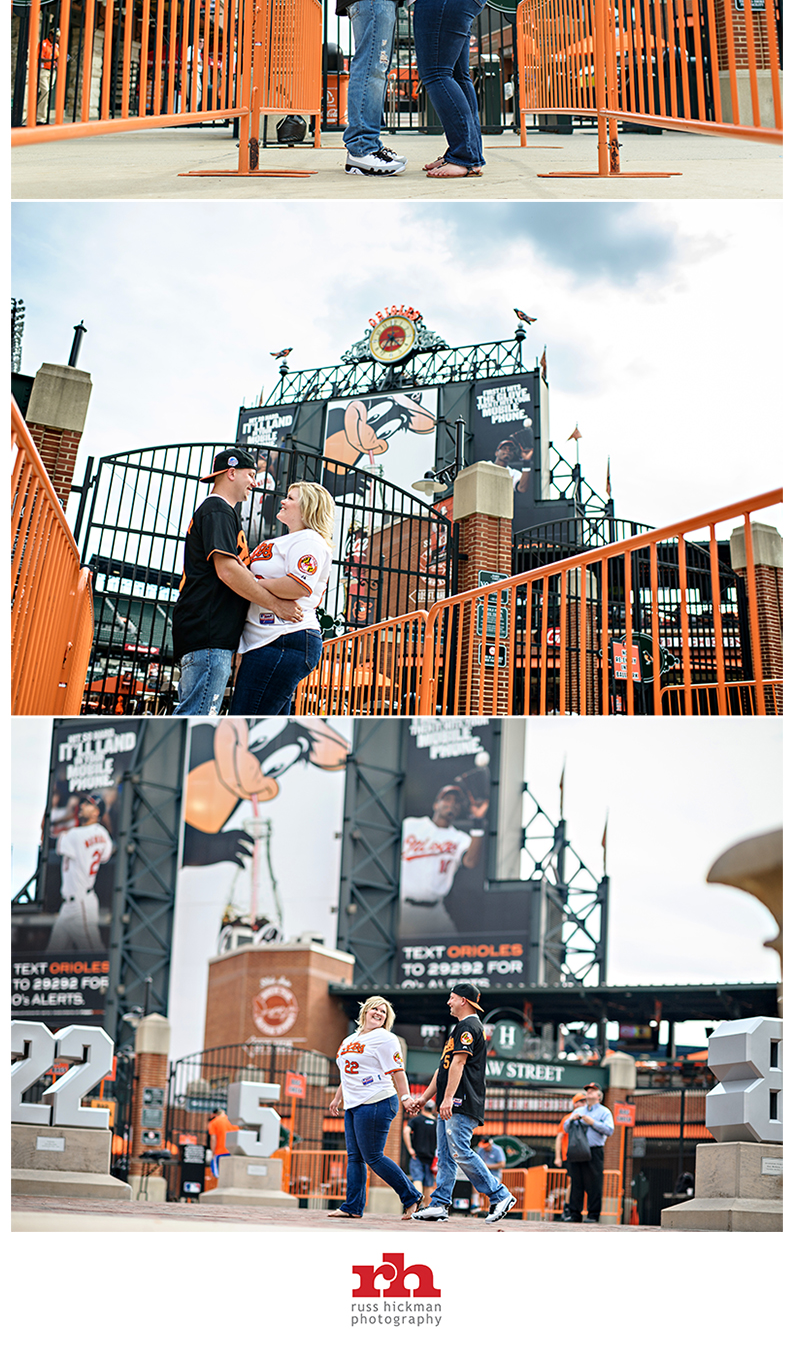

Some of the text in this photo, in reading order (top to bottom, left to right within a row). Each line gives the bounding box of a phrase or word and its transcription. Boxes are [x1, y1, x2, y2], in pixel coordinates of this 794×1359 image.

[368, 304, 424, 327] ORIOLES
[95, 731, 136, 755] LAND
[401, 943, 524, 960] TEXT ORIOLES
[13, 960, 110, 976] TEXT ORIOLES
[401, 960, 524, 977] TO 29292 FOR
[12, 977, 31, 991] TO
[32, 976, 79, 991] 29292
[11, 992, 31, 1007] O's
[499, 1025, 517, 1047] H
[344, 1059, 360, 1075] 22
[443, 1055, 451, 1070] 5
[506, 1062, 565, 1082] STREET
[226, 1080, 282, 1158] 5
